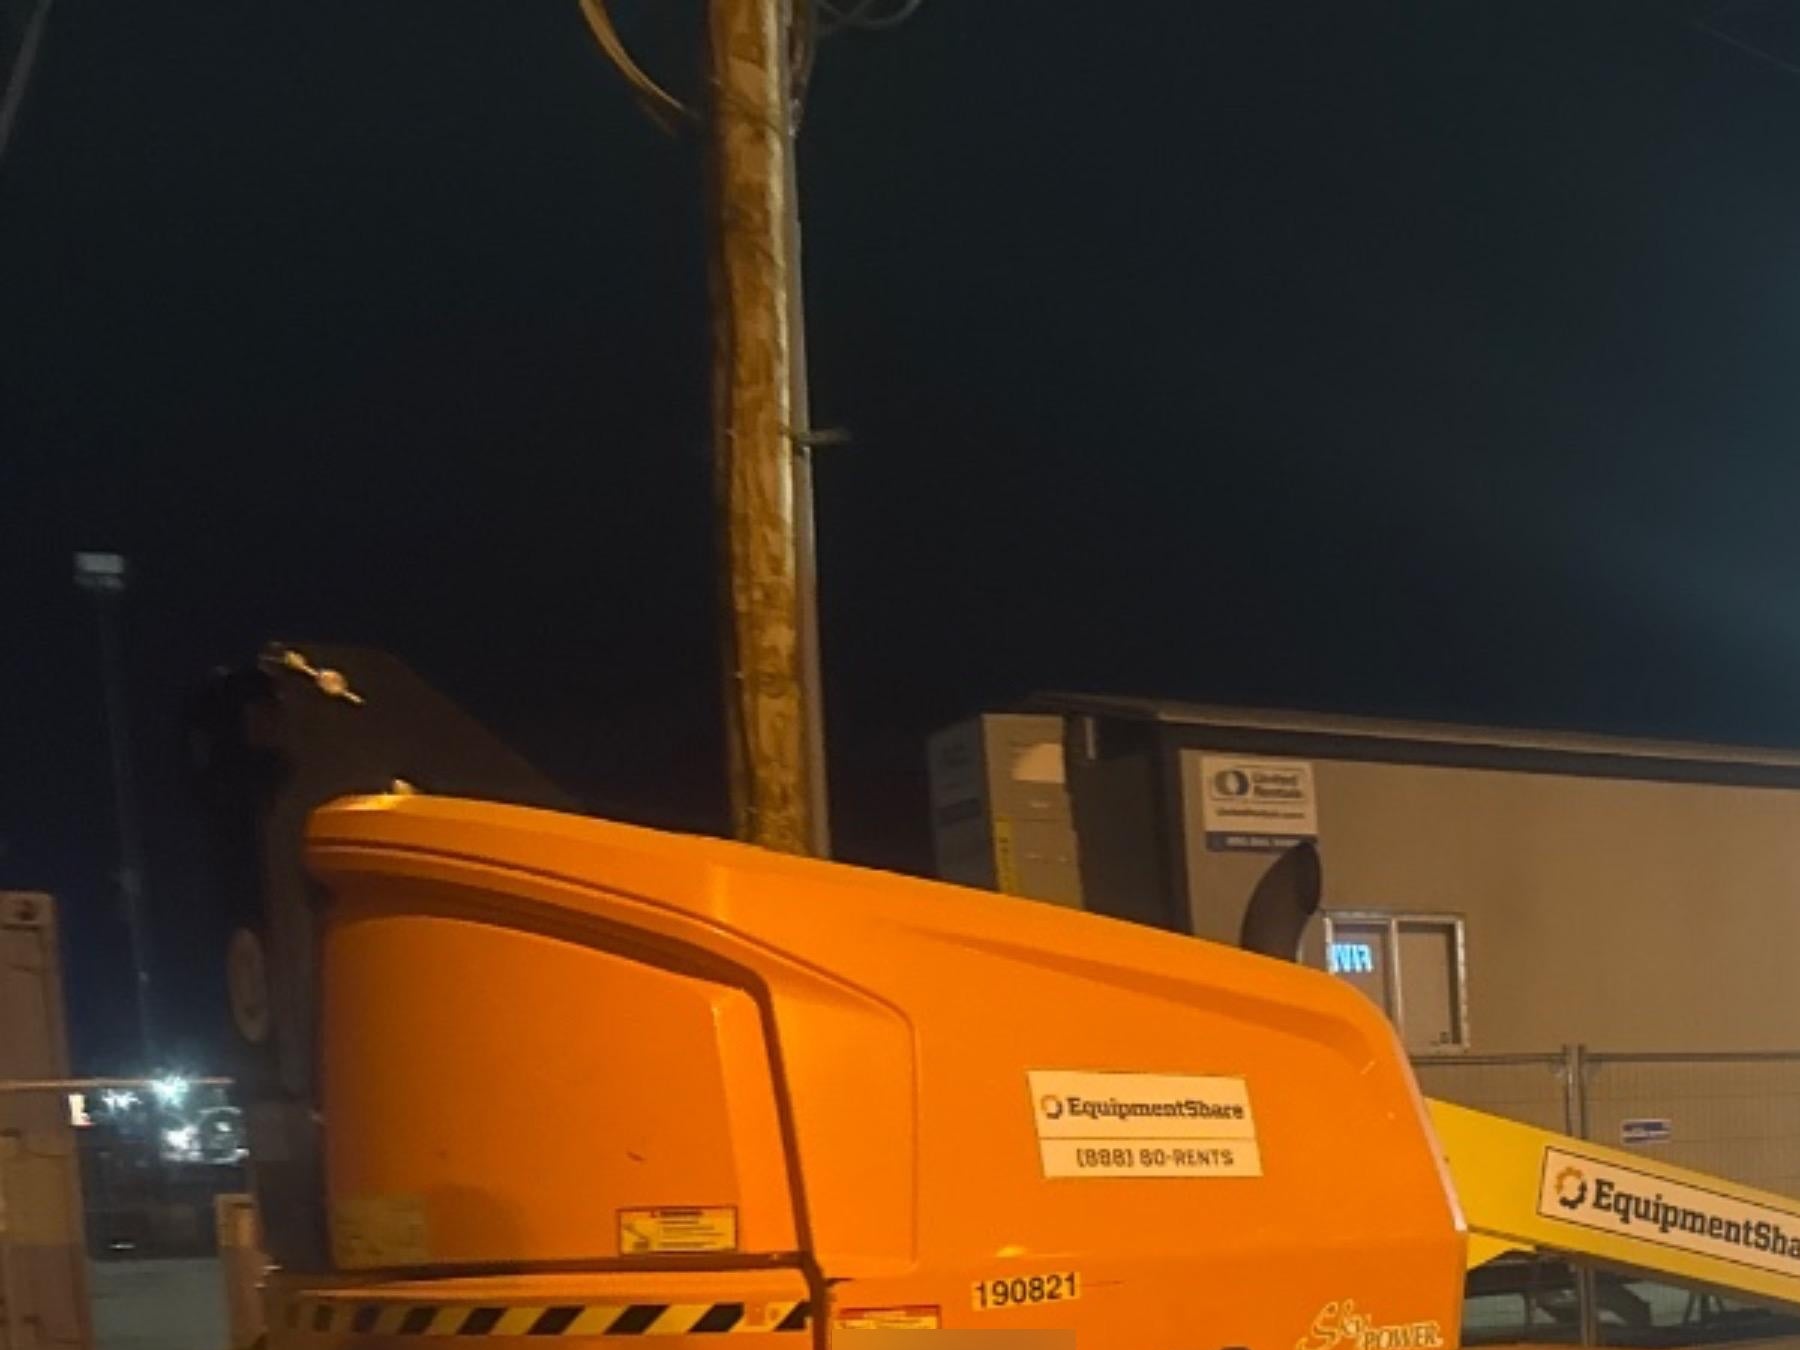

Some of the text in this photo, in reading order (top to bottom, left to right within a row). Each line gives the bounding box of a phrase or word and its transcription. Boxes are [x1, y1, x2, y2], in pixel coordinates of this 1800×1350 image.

[1066, 1097, 1244, 1120] EquipmentShare
[1076, 1148, 1234, 1168] (888) 80-RENTS
[975, 1271, 1076, 1308] 190821
